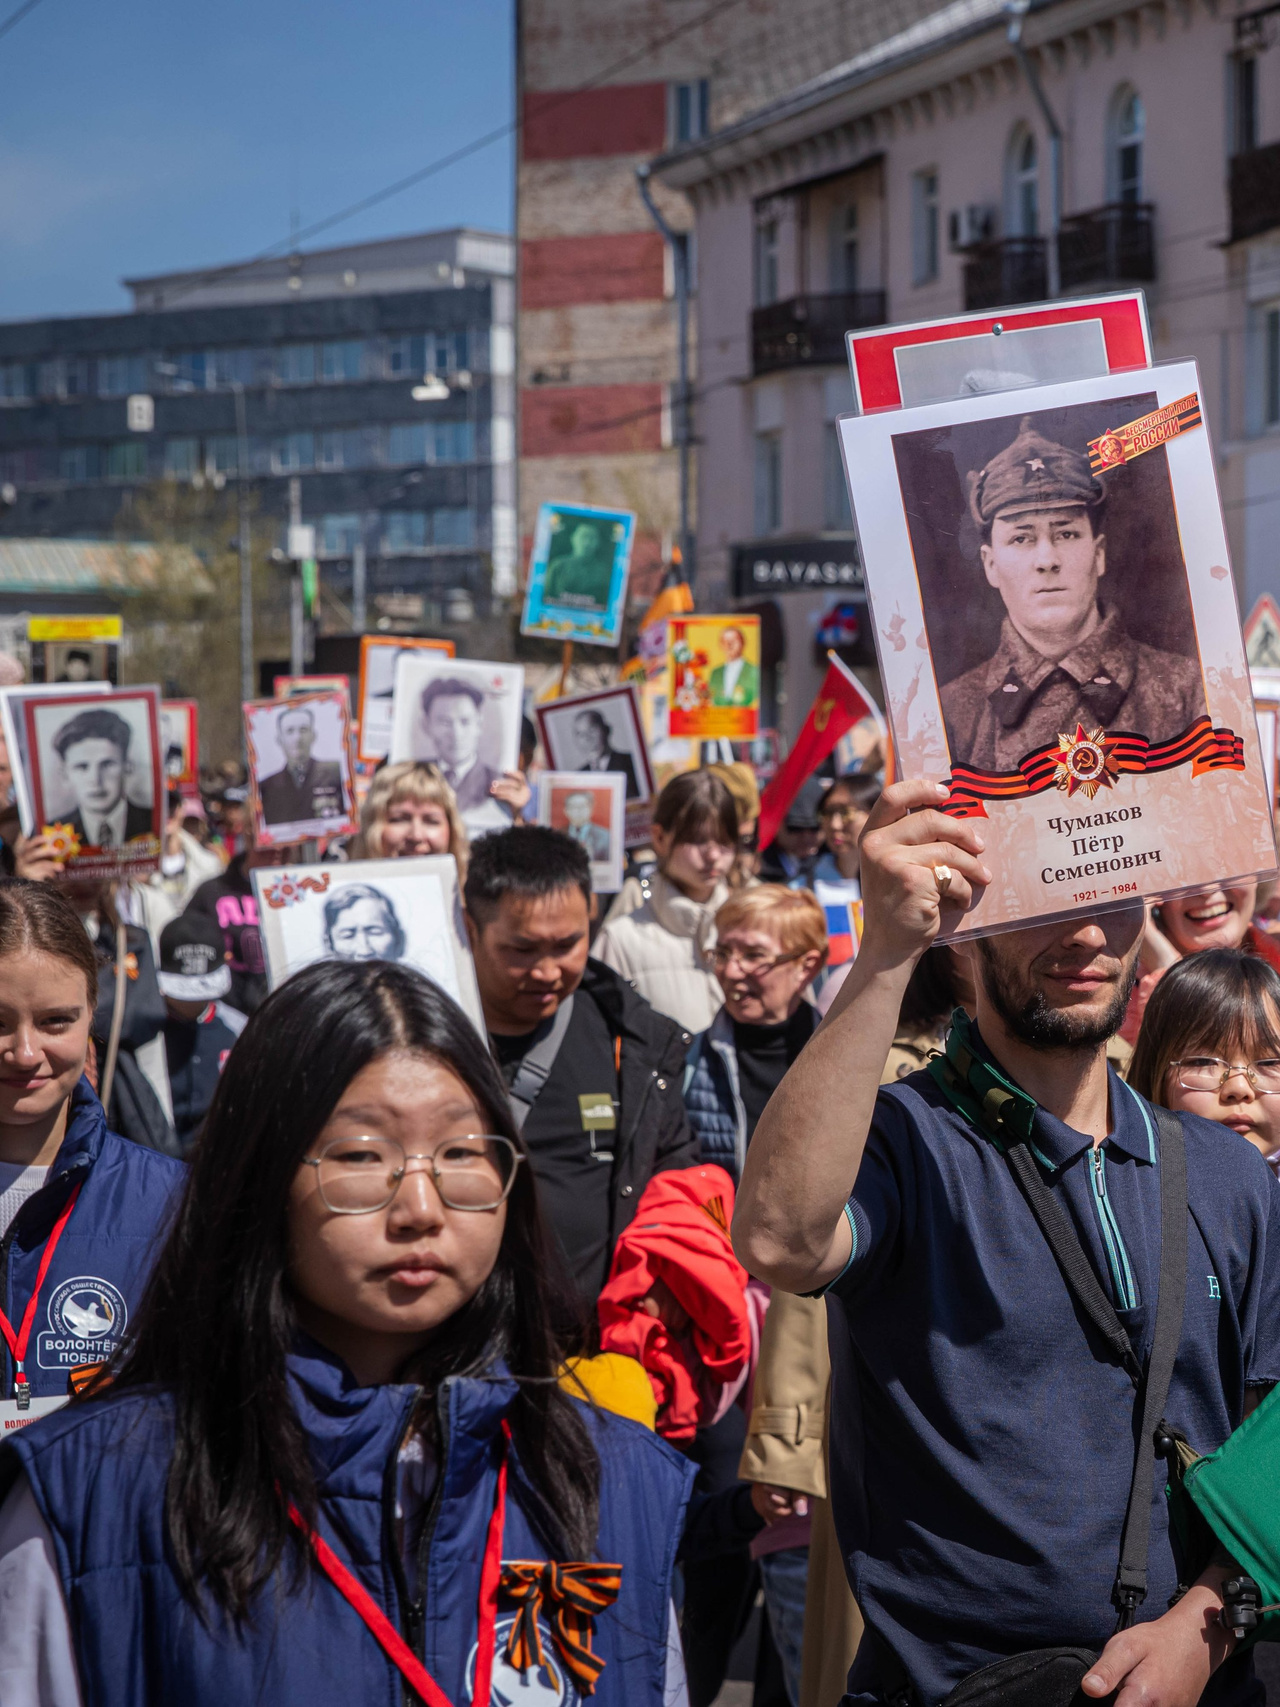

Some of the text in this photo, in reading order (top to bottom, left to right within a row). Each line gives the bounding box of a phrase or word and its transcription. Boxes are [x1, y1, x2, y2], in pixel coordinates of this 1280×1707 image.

[1125, 396, 1197, 438] БЕССМЕРТНЫЙ ПОЛК
[1133, 417, 1180, 453] РОССИИ
[1047, 805, 1143, 838] Чумаков
[1071, 834, 1125, 857] Пётр
[1041, 850, 1162, 885] Семенович
[1073, 889, 1098, 903] 1921
[1111, 881, 1138, 896] 1984
[45, 1339, 119, 1352] ВОЛОНТЁР
